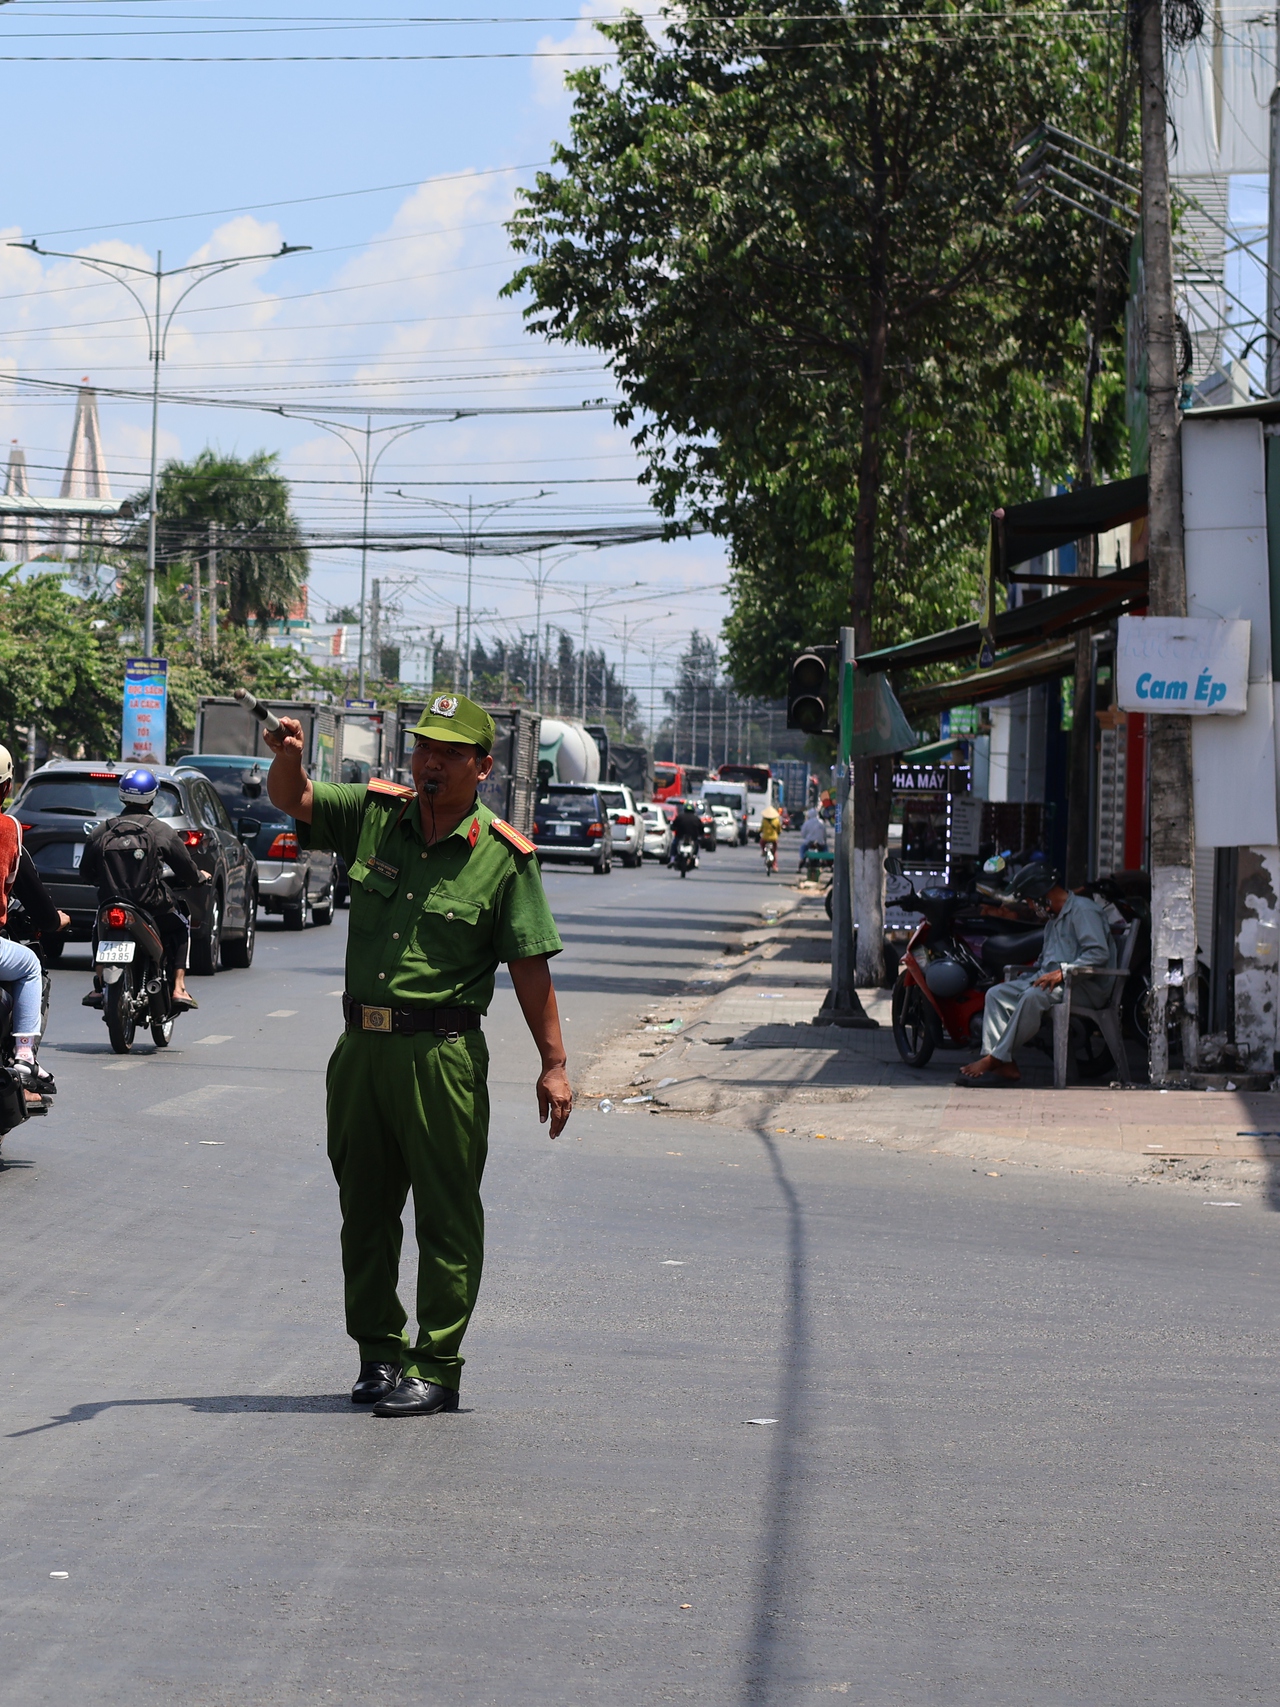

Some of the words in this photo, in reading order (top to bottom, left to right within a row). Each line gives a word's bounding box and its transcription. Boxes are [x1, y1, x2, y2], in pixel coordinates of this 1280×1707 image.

[1135, 671, 1189, 701] Cam
[1193, 666, 1227, 708] Ép
[892, 772, 915, 789] HA
[917, 769, 946, 789] MÁY
[103, 942, 128, 952] 71-G1
[99, 952, 130, 961] 013.85
